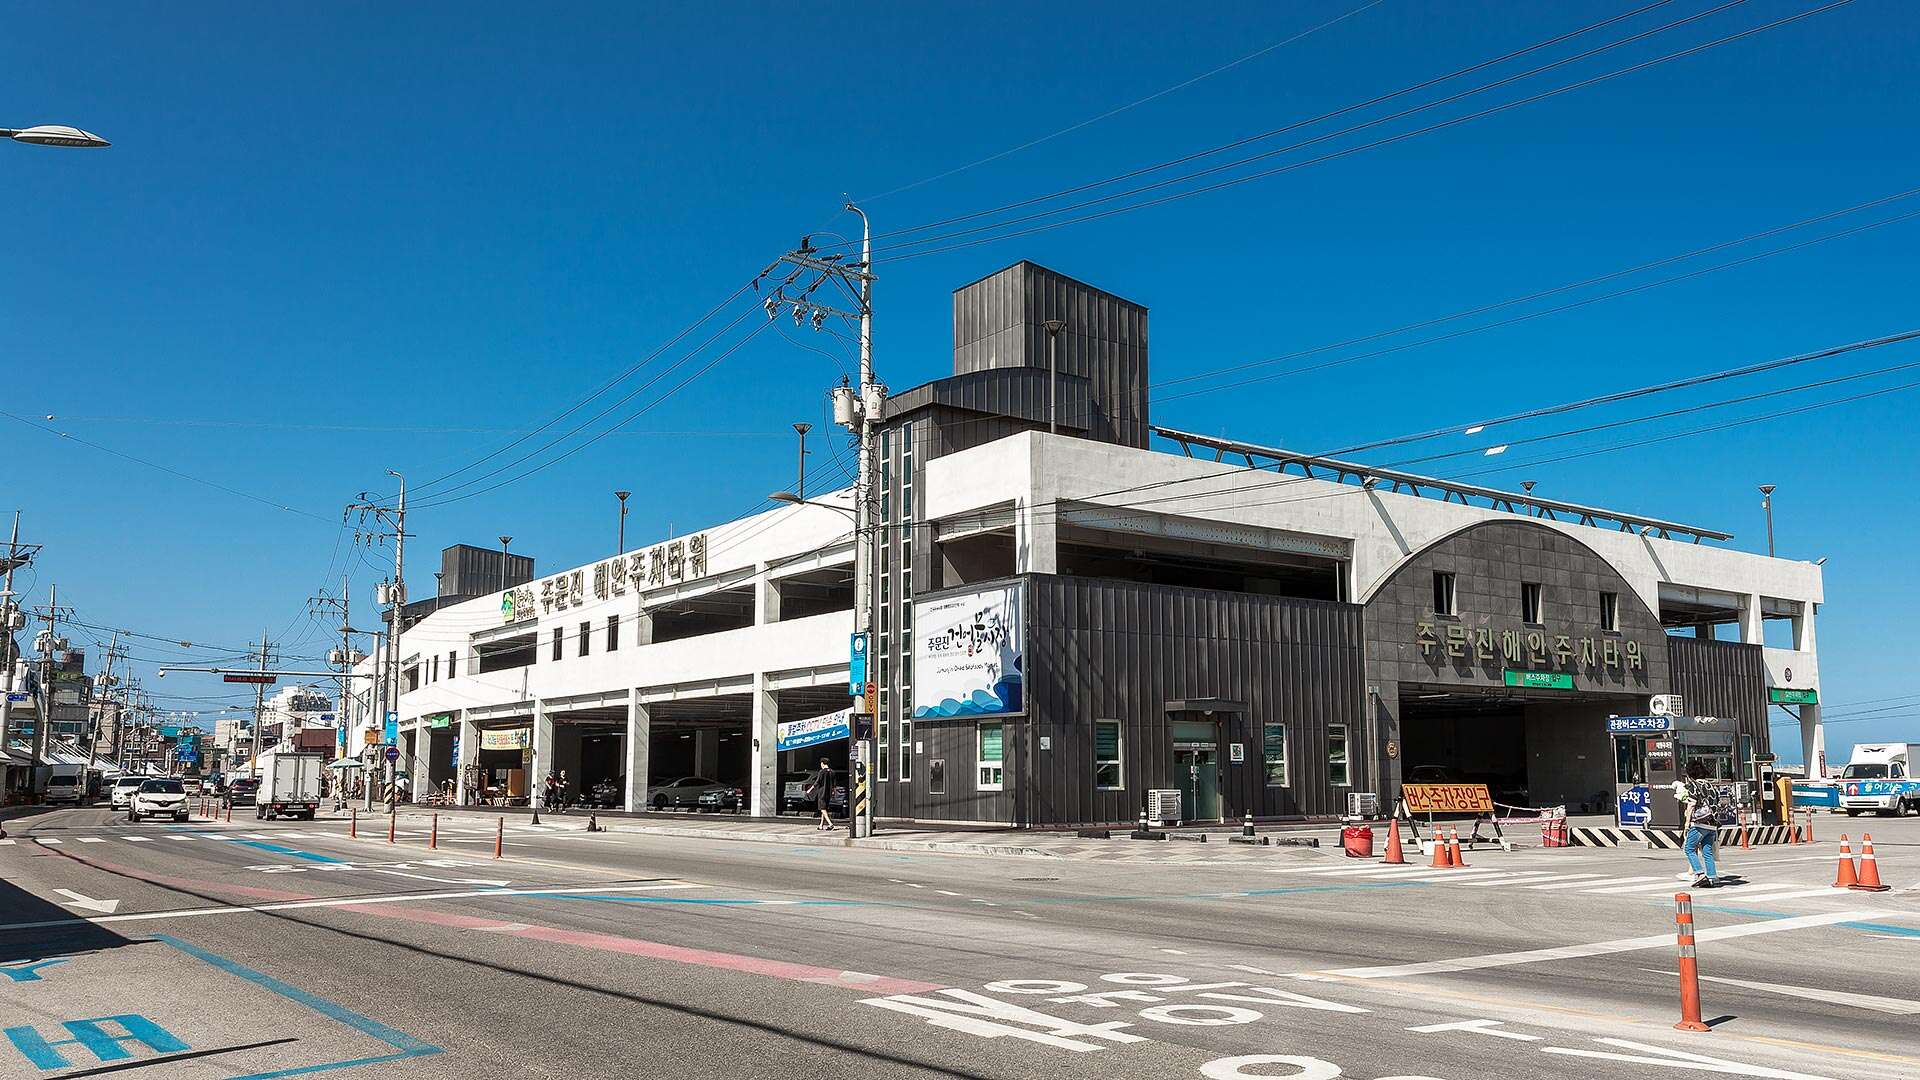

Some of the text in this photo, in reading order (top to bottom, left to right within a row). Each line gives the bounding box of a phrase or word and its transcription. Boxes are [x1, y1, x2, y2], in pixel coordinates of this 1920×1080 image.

[540, 569, 584, 615] 주문진
[593, 534, 708, 601] 해안주차타워
[927, 635, 950, 651] 주문진
[947, 611, 1007, 654] 건어물시장
[1415, 621, 1643, 670] 주문진해안주차타워
[1405, 787, 1490, 809] 버스주차장입구
[1620, 791, 1641, 804] 주차장
